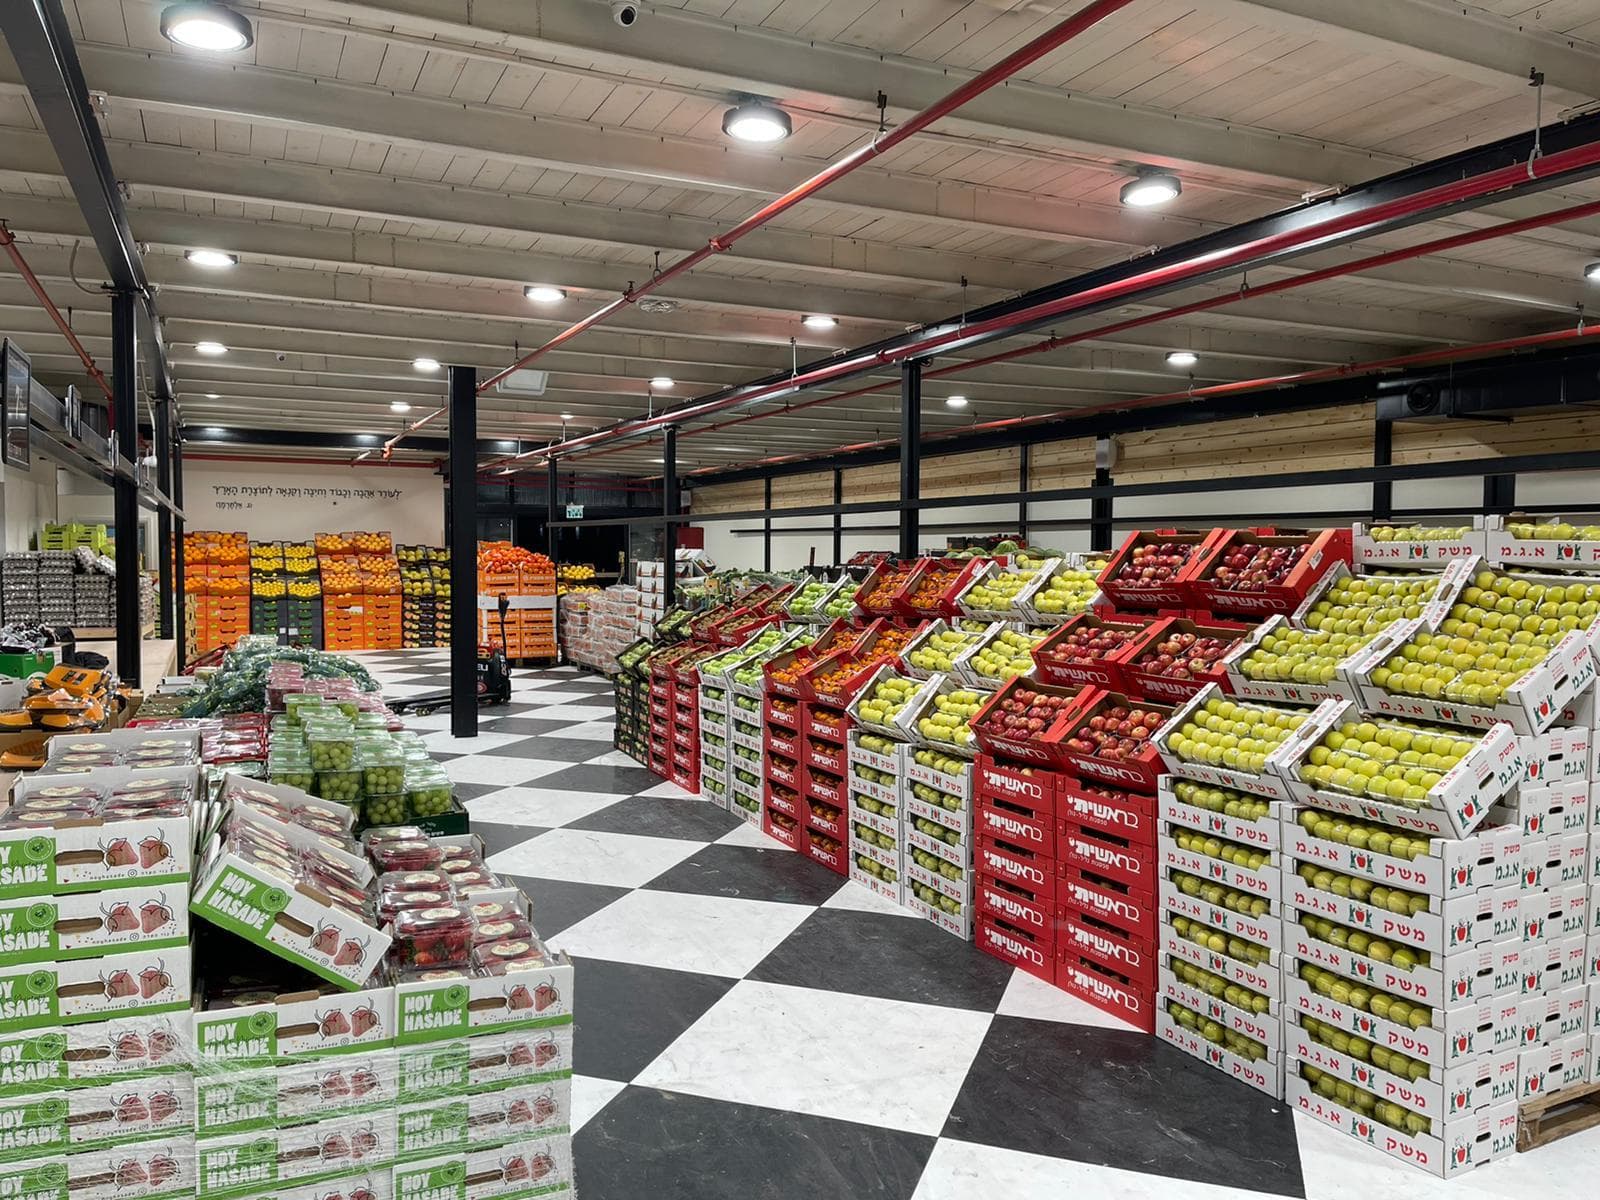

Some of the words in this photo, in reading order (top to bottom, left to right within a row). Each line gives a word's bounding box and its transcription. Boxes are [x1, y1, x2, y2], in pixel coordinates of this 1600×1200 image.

[1235, 826, 1269, 843] משק
[1235, 873, 1268, 892] משק
[1385, 864, 1427, 885] משק
[1236, 921, 1268, 940] משק
[1383, 920, 1425, 942] משק
[1235, 968, 1268, 989] משק
[1385, 974, 1427, 997] משק
[1234, 1016, 1266, 1039] משק
[1388, 1031, 1429, 1056] משק
[1233, 1062, 1265, 1086] משק
[1385, 1082, 1426, 1108] משק
[1386, 1137, 1428, 1164] משק
